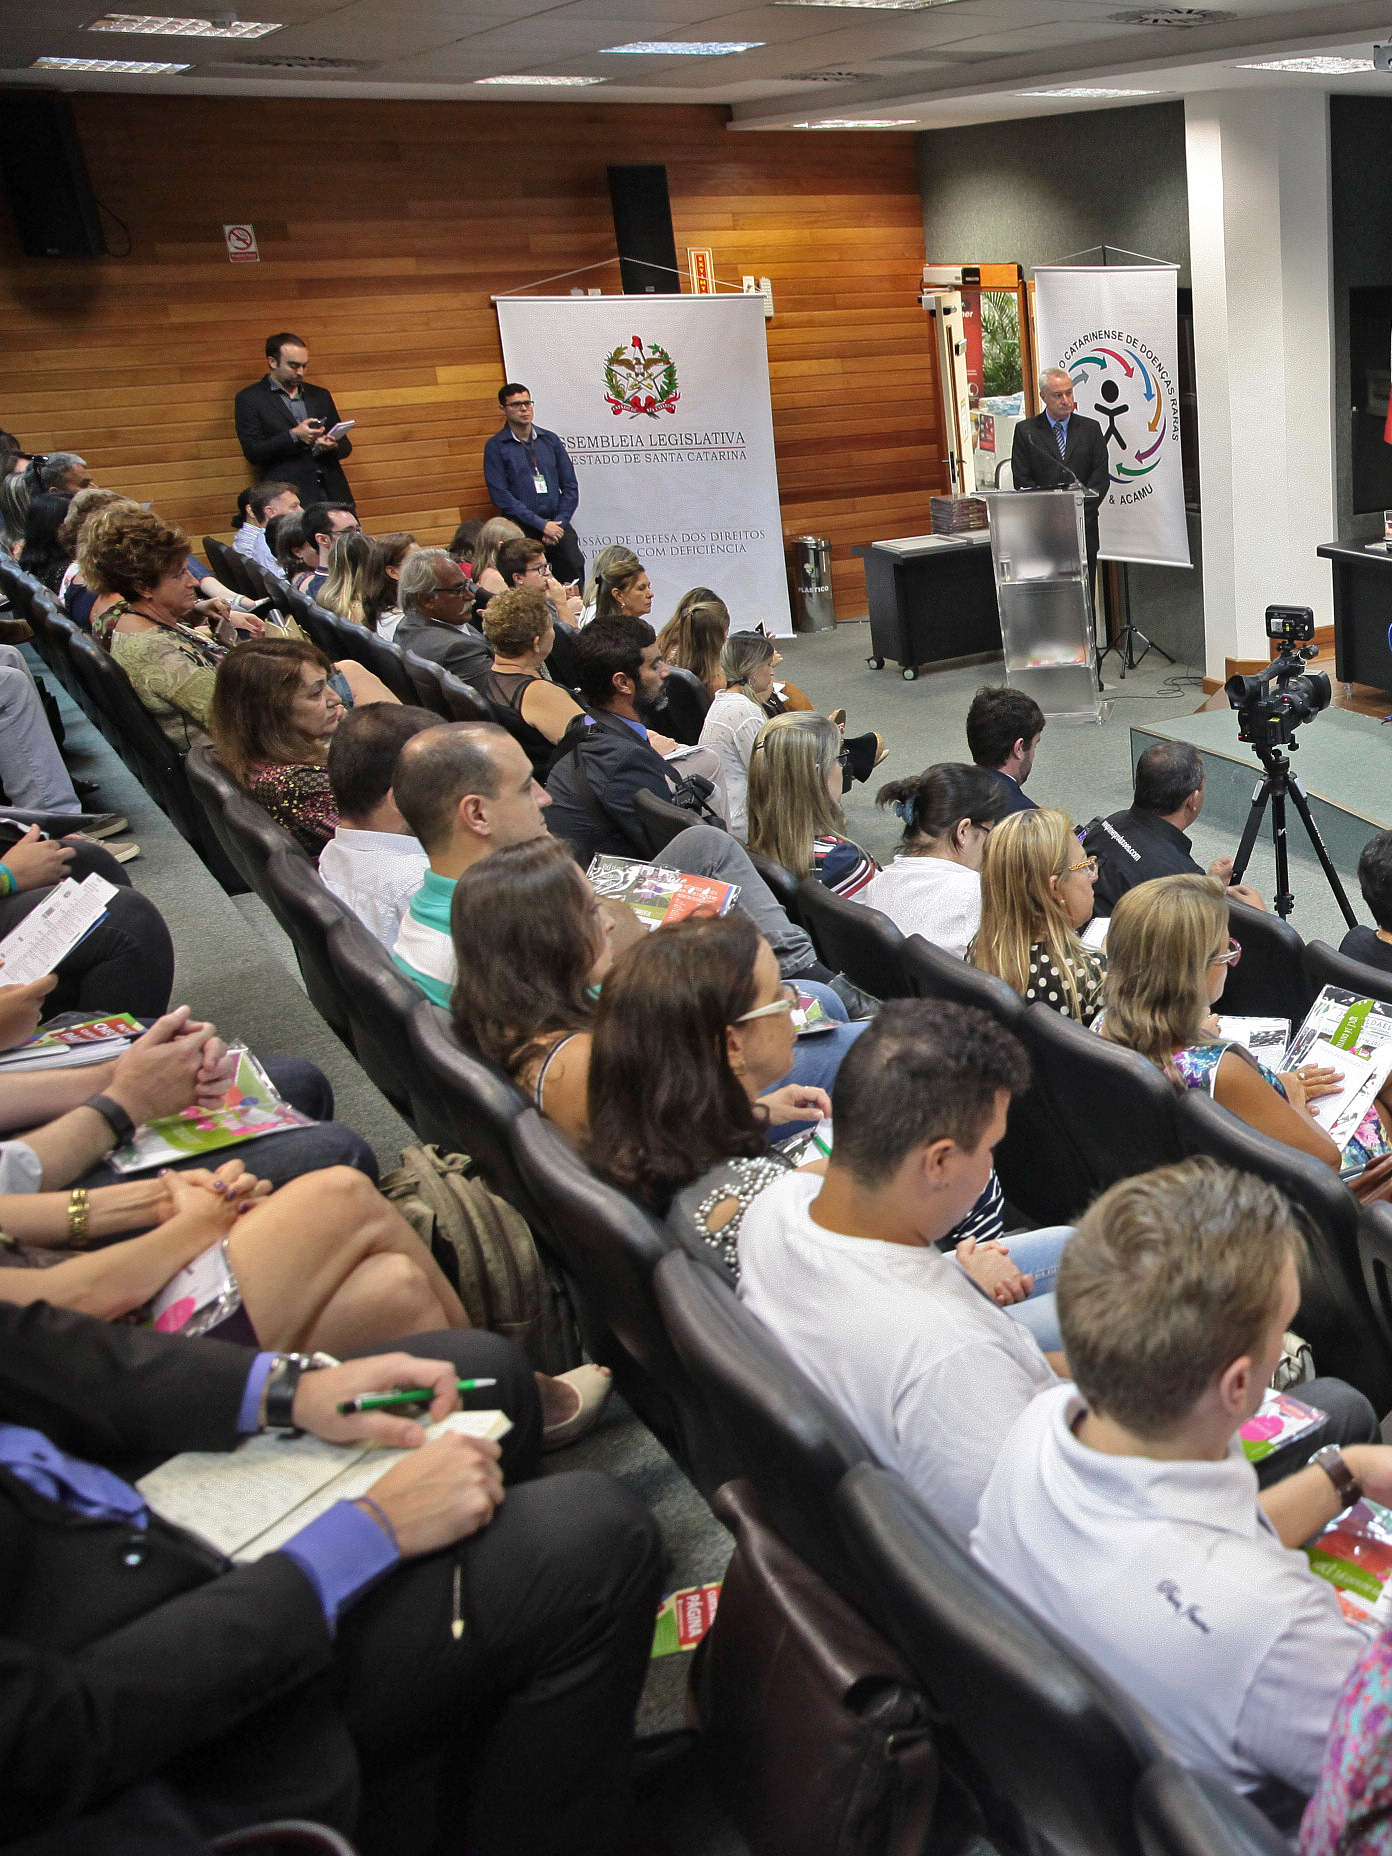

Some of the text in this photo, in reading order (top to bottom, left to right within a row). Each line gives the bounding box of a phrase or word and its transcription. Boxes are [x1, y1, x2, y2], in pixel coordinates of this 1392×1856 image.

[1064, 329, 1124, 361] CATARINENSE
[1125, 335, 1140, 349] DE
[1139, 343, 1175, 396] DOENÇAS
[1170, 397, 1179, 442] RARAS
[560, 431, 746, 449] SSEMBLEIA LEGISLATIVA
[572, 450, 747, 466] ESTADO DE SANTA CATARINA
[1108, 484, 1154, 506] & ACAMU
[578, 530, 766, 547] ISSÃO DE DEFESA DOS DIREITOS
[636, 546, 666, 558] COM
[670, 542, 748, 556] DEFICIÊNCIA
[686, 1594, 704, 1639] PÁGINA
